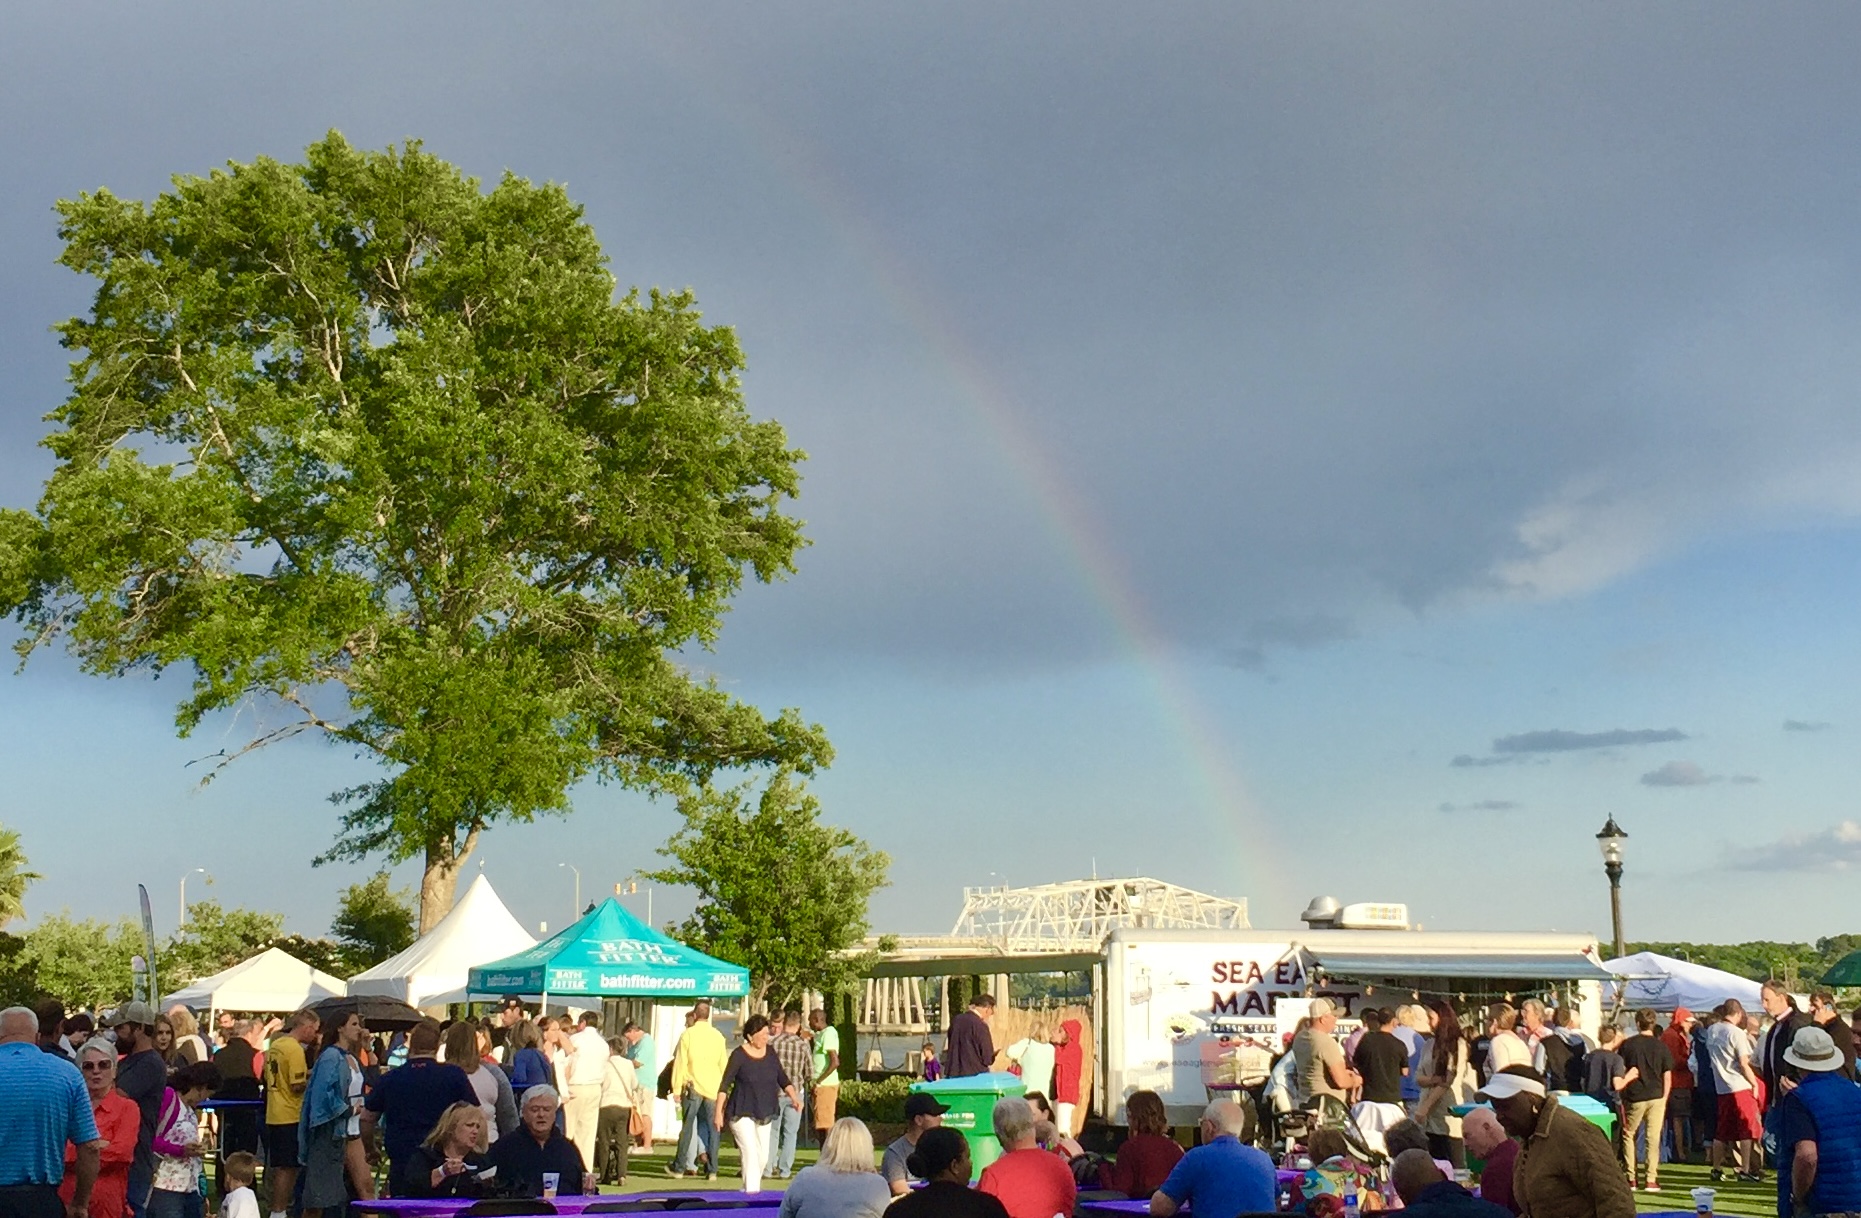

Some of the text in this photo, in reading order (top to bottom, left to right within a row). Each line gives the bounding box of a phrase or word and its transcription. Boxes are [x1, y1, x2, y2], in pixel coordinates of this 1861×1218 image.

[601, 940, 663, 954] BATH
[556, 970, 582, 979] BATH
[1212, 961, 1264, 984] SEA
[600, 973, 696, 990] bathfitter.com
[1212, 1024, 1245, 1033] FRESH
